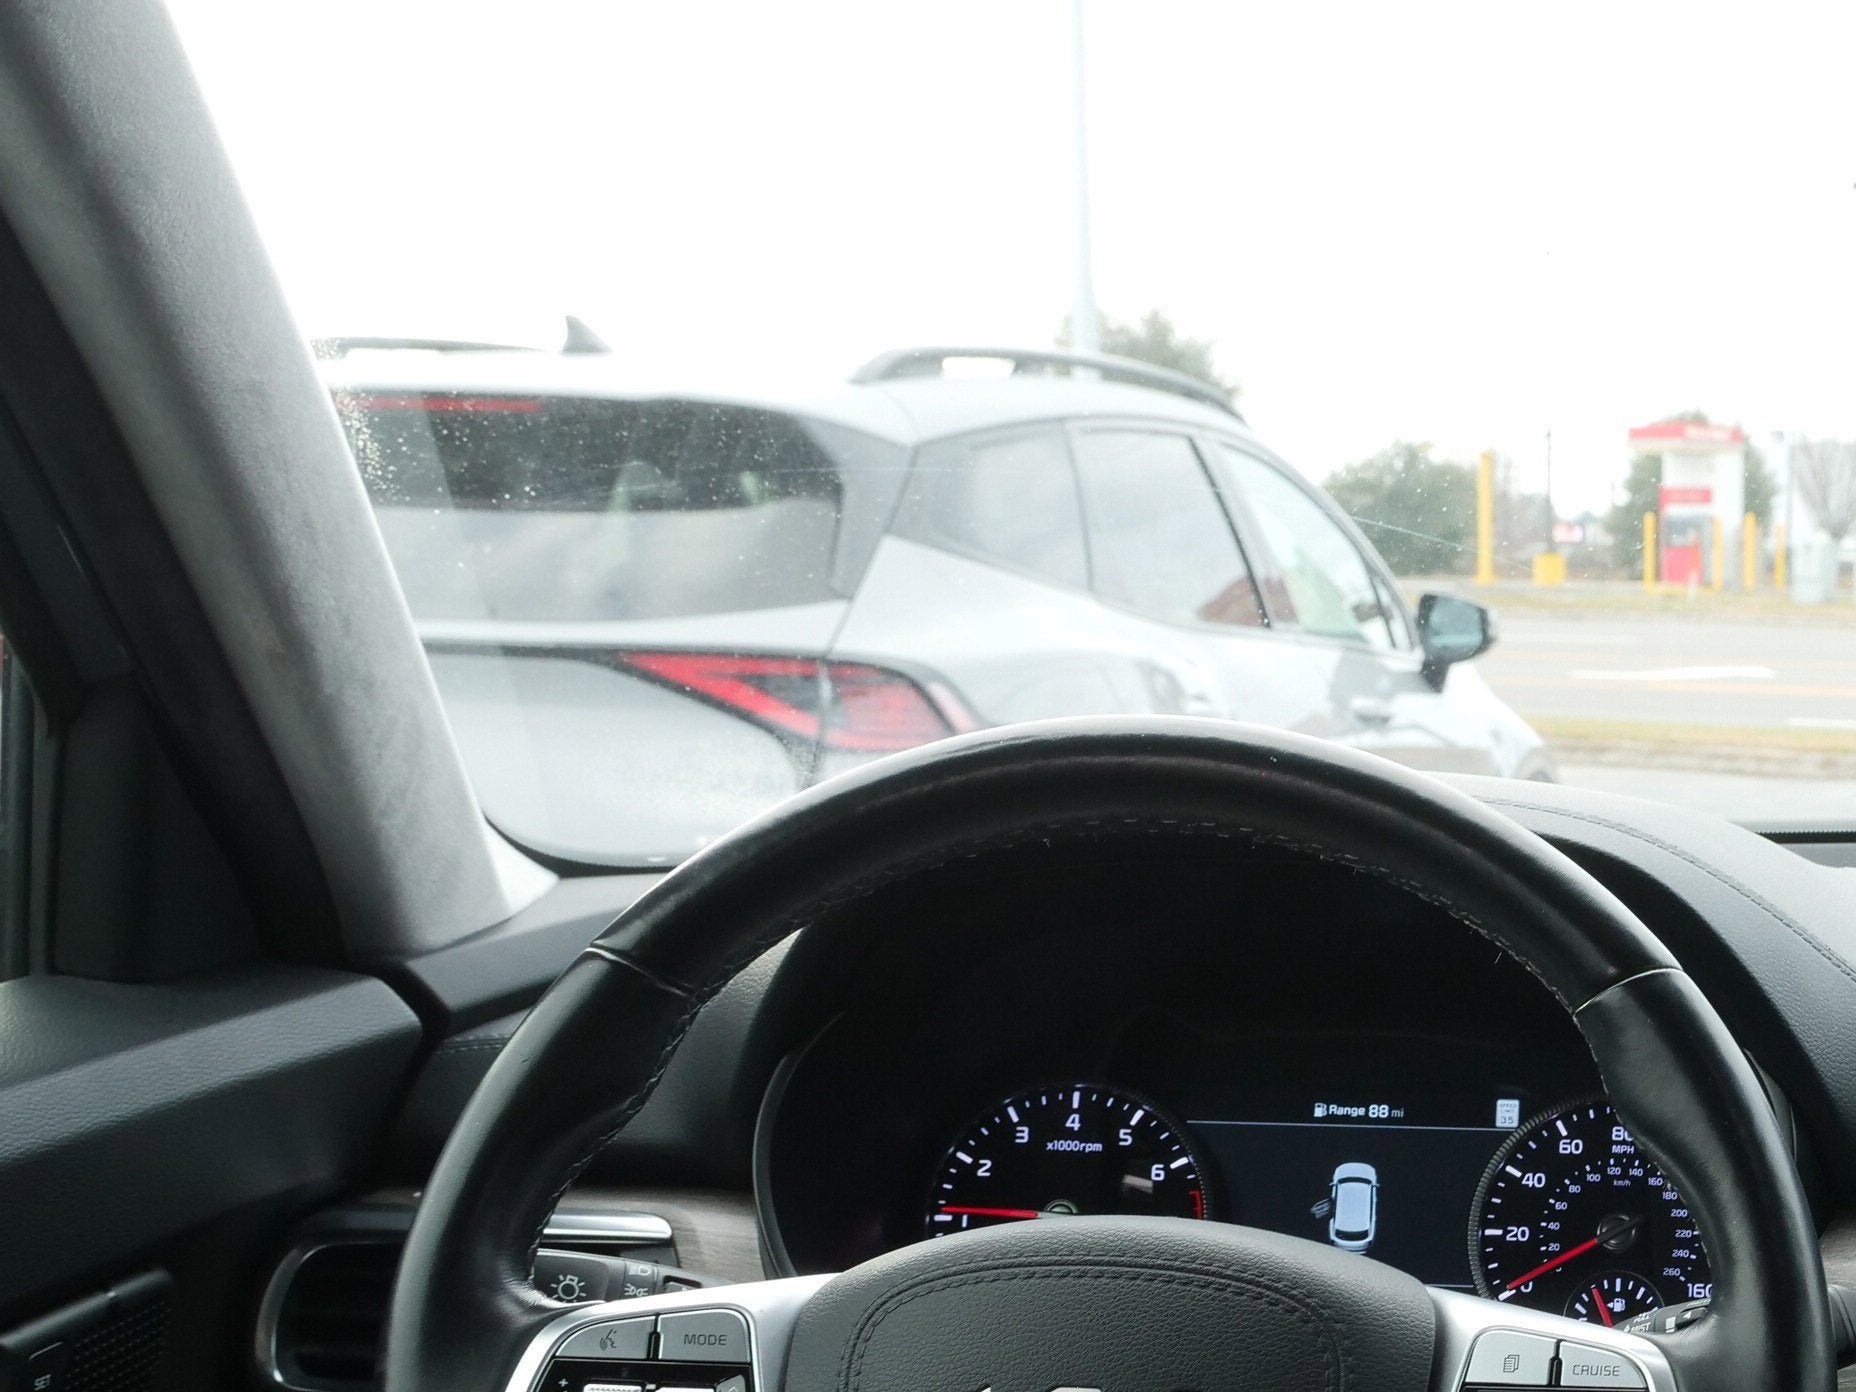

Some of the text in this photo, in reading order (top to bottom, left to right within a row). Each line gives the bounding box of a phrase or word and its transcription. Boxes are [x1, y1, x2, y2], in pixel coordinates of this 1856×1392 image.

[1329, 1105, 1404, 1118] Range 88 mi
[1066, 1114, 1080, 1131] 4
[1501, 1116, 1514, 1124] 35
[1015, 1127, 1029, 1143] 3
[1119, 1129, 1133, 1146] 5
[1046, 1140, 1103, 1153] x1000rpm
[1559, 1140, 1583, 1155] 60
[1612, 1145, 1635, 1155] MPH
[977, 1160, 992, 1177] 2
[1151, 1164, 1165, 1181] 6
[1607, 1167, 1622, 1176] 120
[1629, 1168, 1644, 1177] 140
[1522, 1173, 1546, 1189] 40
[1586, 1173, 1601, 1183] 100
[1613, 1179, 1632, 1187] km/h
[1648, 1178, 1664, 1186] 160
[1569, 1184, 1581, 1194] 80
[1662, 1191, 1678, 1200] 180
[1555, 1201, 1568, 1211] 60
[1671, 1209, 1688, 1217] 200
[1548, 1221, 1560, 1230] 40
[1506, 1226, 1530, 1242] 20
[1675, 1230, 1692, 1238] 220
[1548, 1242, 1560, 1251] 20
[1672, 1250, 1689, 1258] 240
[1663, 1268, 1681, 1276] 260
[684, 1334, 728, 1346] MODE
[1572, 1364, 1620, 1377] CRUISE
